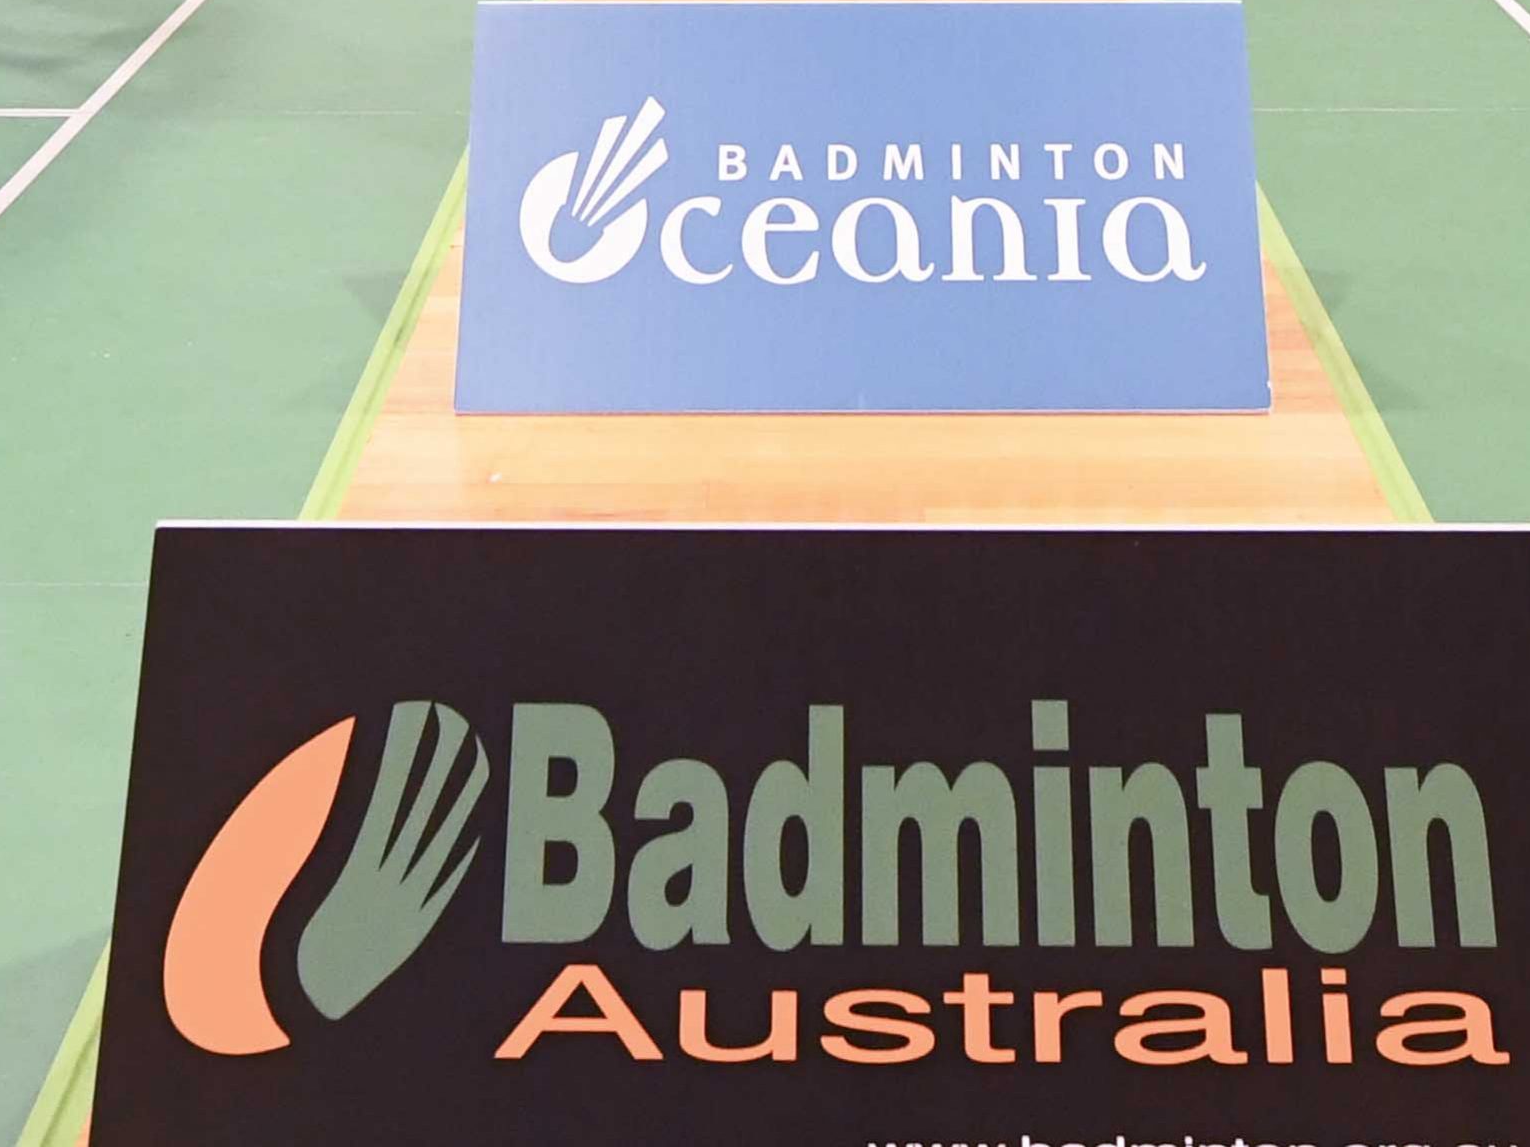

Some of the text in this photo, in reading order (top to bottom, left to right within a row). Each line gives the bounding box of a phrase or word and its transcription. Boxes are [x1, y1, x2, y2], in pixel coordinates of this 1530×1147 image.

[719, 143, 1184, 181] BADMINTON
[501, 699, 1498, 954] Badminton
[494, 964, 1510, 1066] Australia
